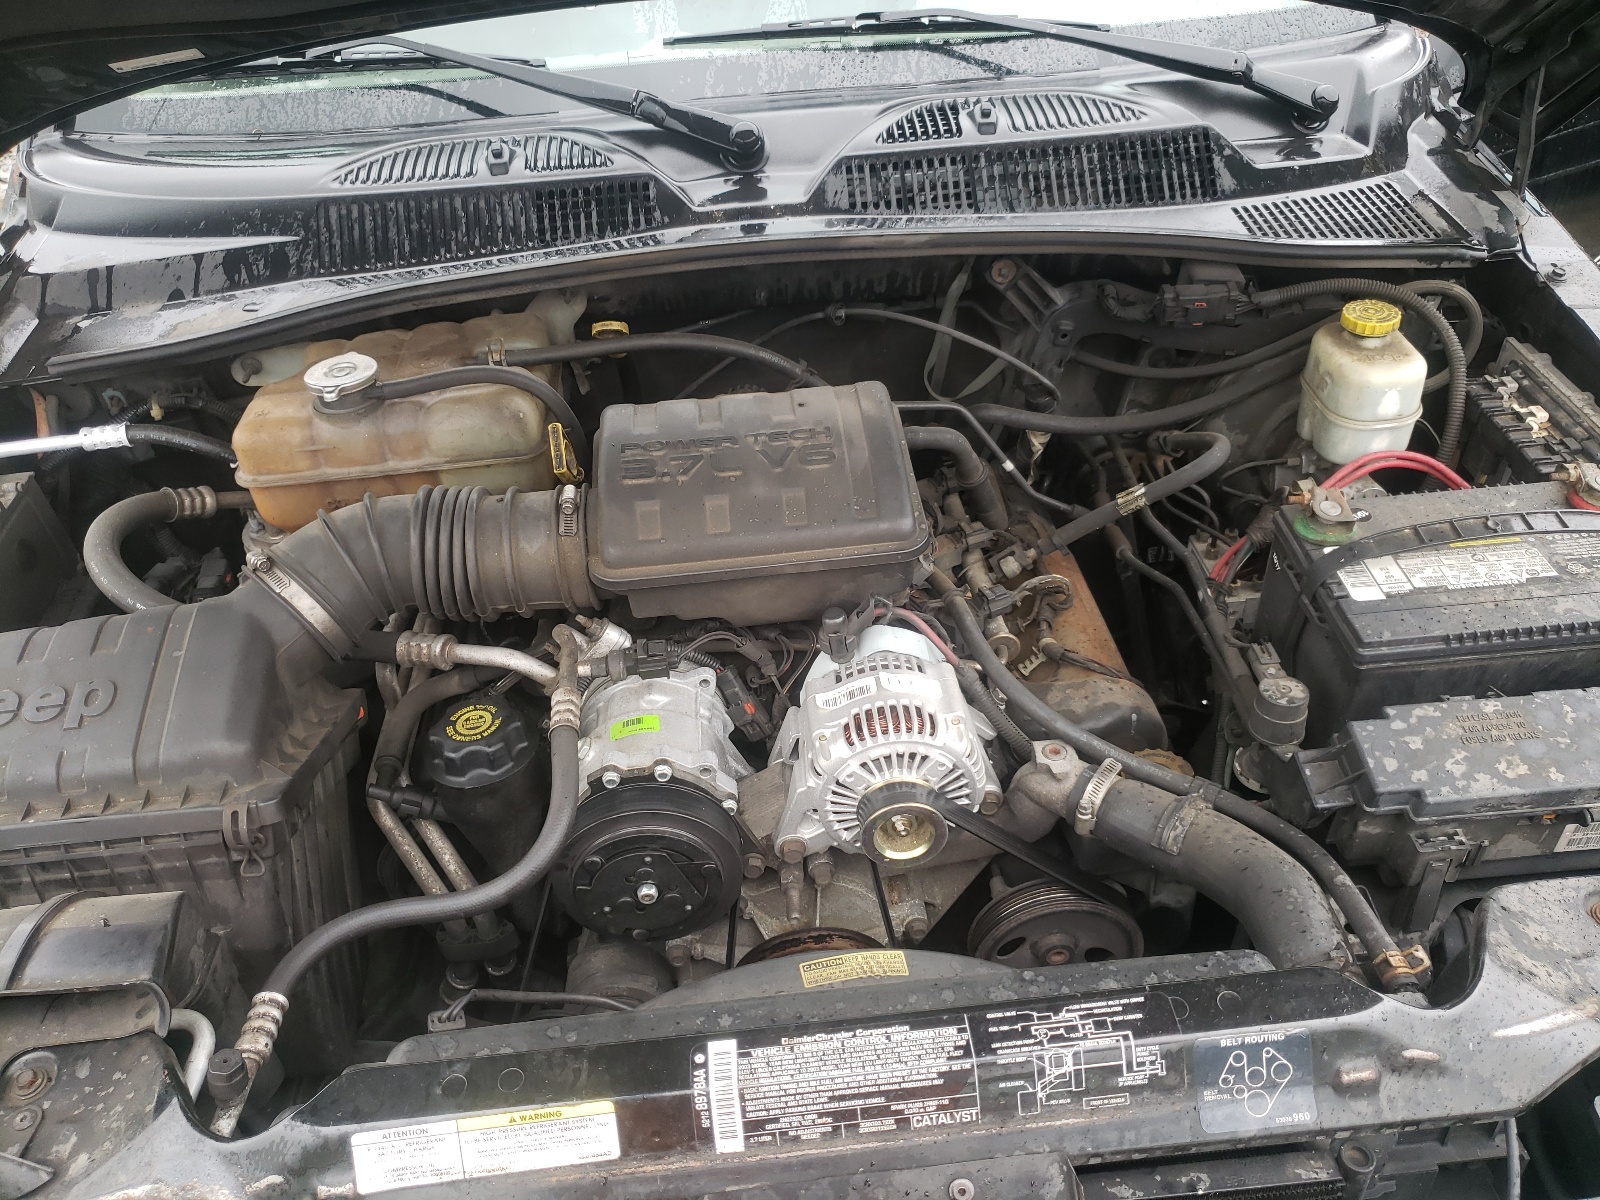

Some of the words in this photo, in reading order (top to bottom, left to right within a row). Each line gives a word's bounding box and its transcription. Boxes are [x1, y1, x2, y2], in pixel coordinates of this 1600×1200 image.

[620, 435, 740, 454] POWER
[744, 426, 832, 446] TECH
[620, 452, 744, 486] 3.7L
[753, 443, 838, 473] V6
[1456, 713, 1494, 723] RELEASE
[1460, 735, 1488, 745] FUSES
[1507, 730, 1540, 740] RELAYS
[804, 958, 843, 972] CAUTION
[751, 1045, 792, 1056] VEHICLE
[793, 1040, 842, 1052] EMISSION
[843, 1035, 888, 1047] CONTROL
[890, 1027, 957, 1042] INFORMATION
[782, 1031, 854, 1045] DaimlerChrysler
[855, 1025, 910, 1037] Corporation
[1220, 1037, 1242, 1048] BELT
[1244, 1032, 1285, 1044] ROUTING
[520, 1110, 562, 1122] WARNING
[913, 1110, 978, 1128] CATALYST
[382, 1128, 429, 1140] ATTENTION
[498, 1126, 528, 1134] PRESSURE
[529, 1121, 570, 1130] REFRIGERANT
